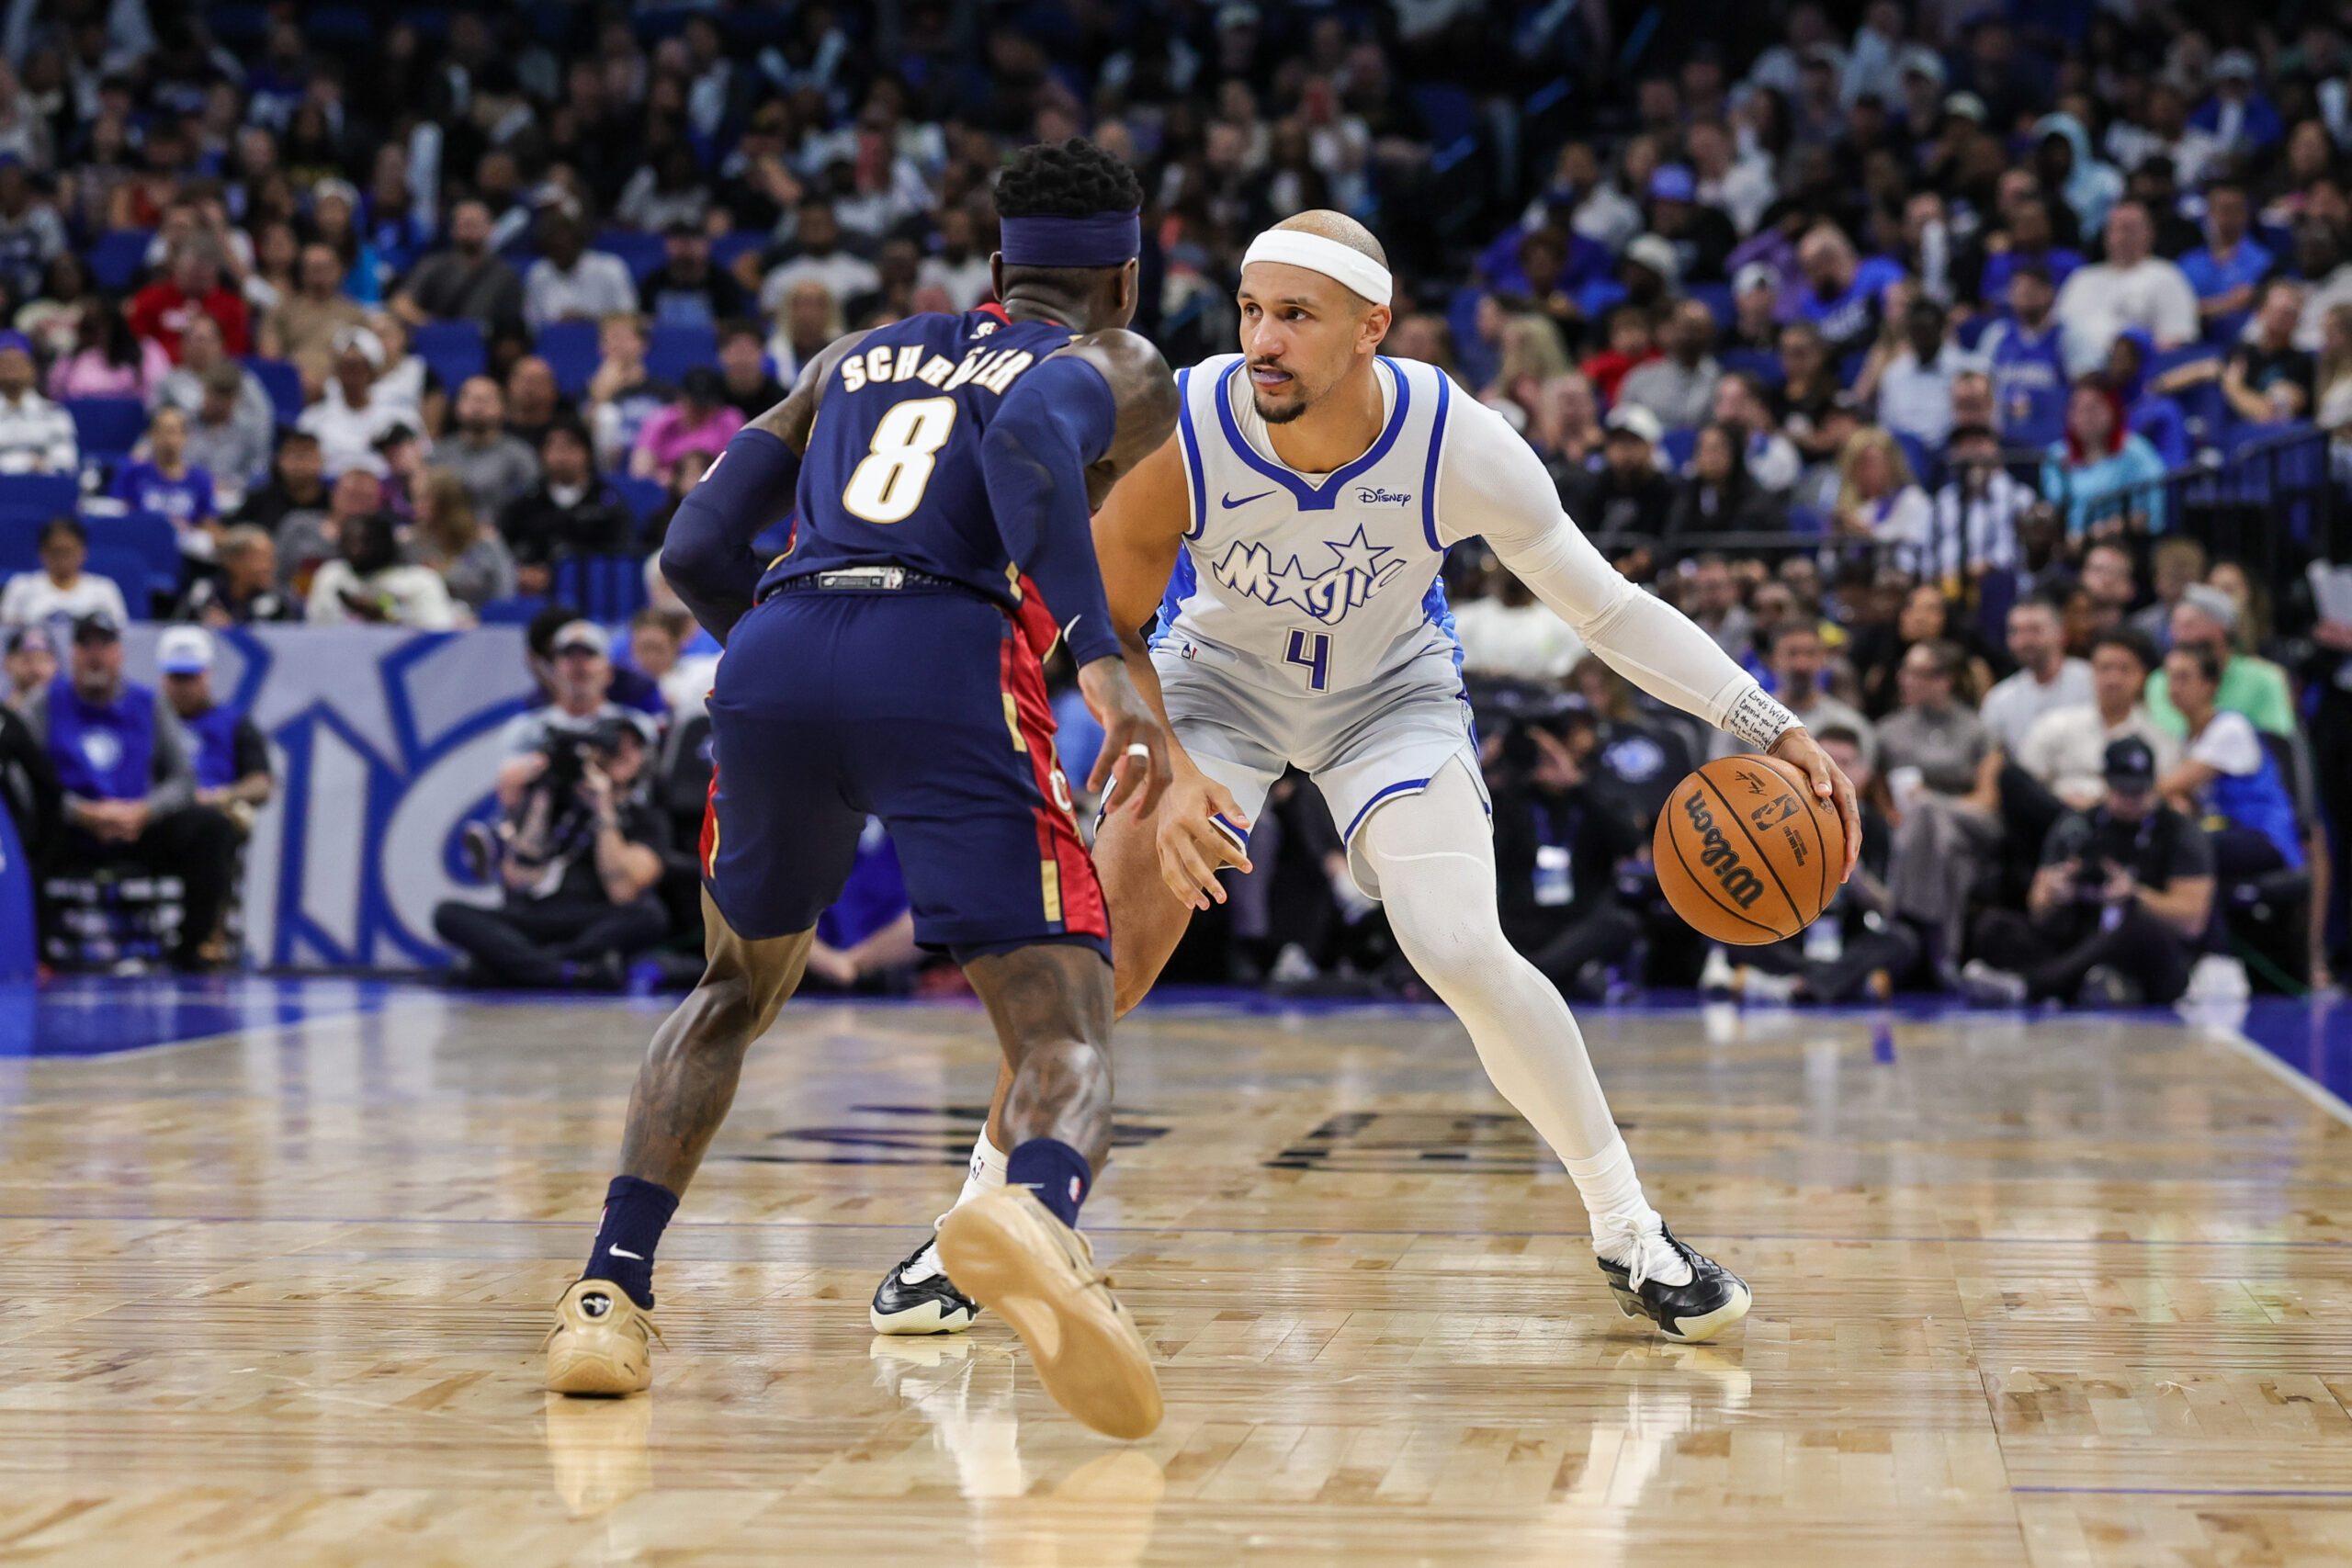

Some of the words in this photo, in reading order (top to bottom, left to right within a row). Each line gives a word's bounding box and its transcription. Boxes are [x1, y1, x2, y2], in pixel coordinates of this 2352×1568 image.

[842, 396, 957, 524] 8
[1355, 487, 1411, 507] Disney
[1281, 626, 1333, 694] 4
[1684, 788, 1764, 910] Wilson
